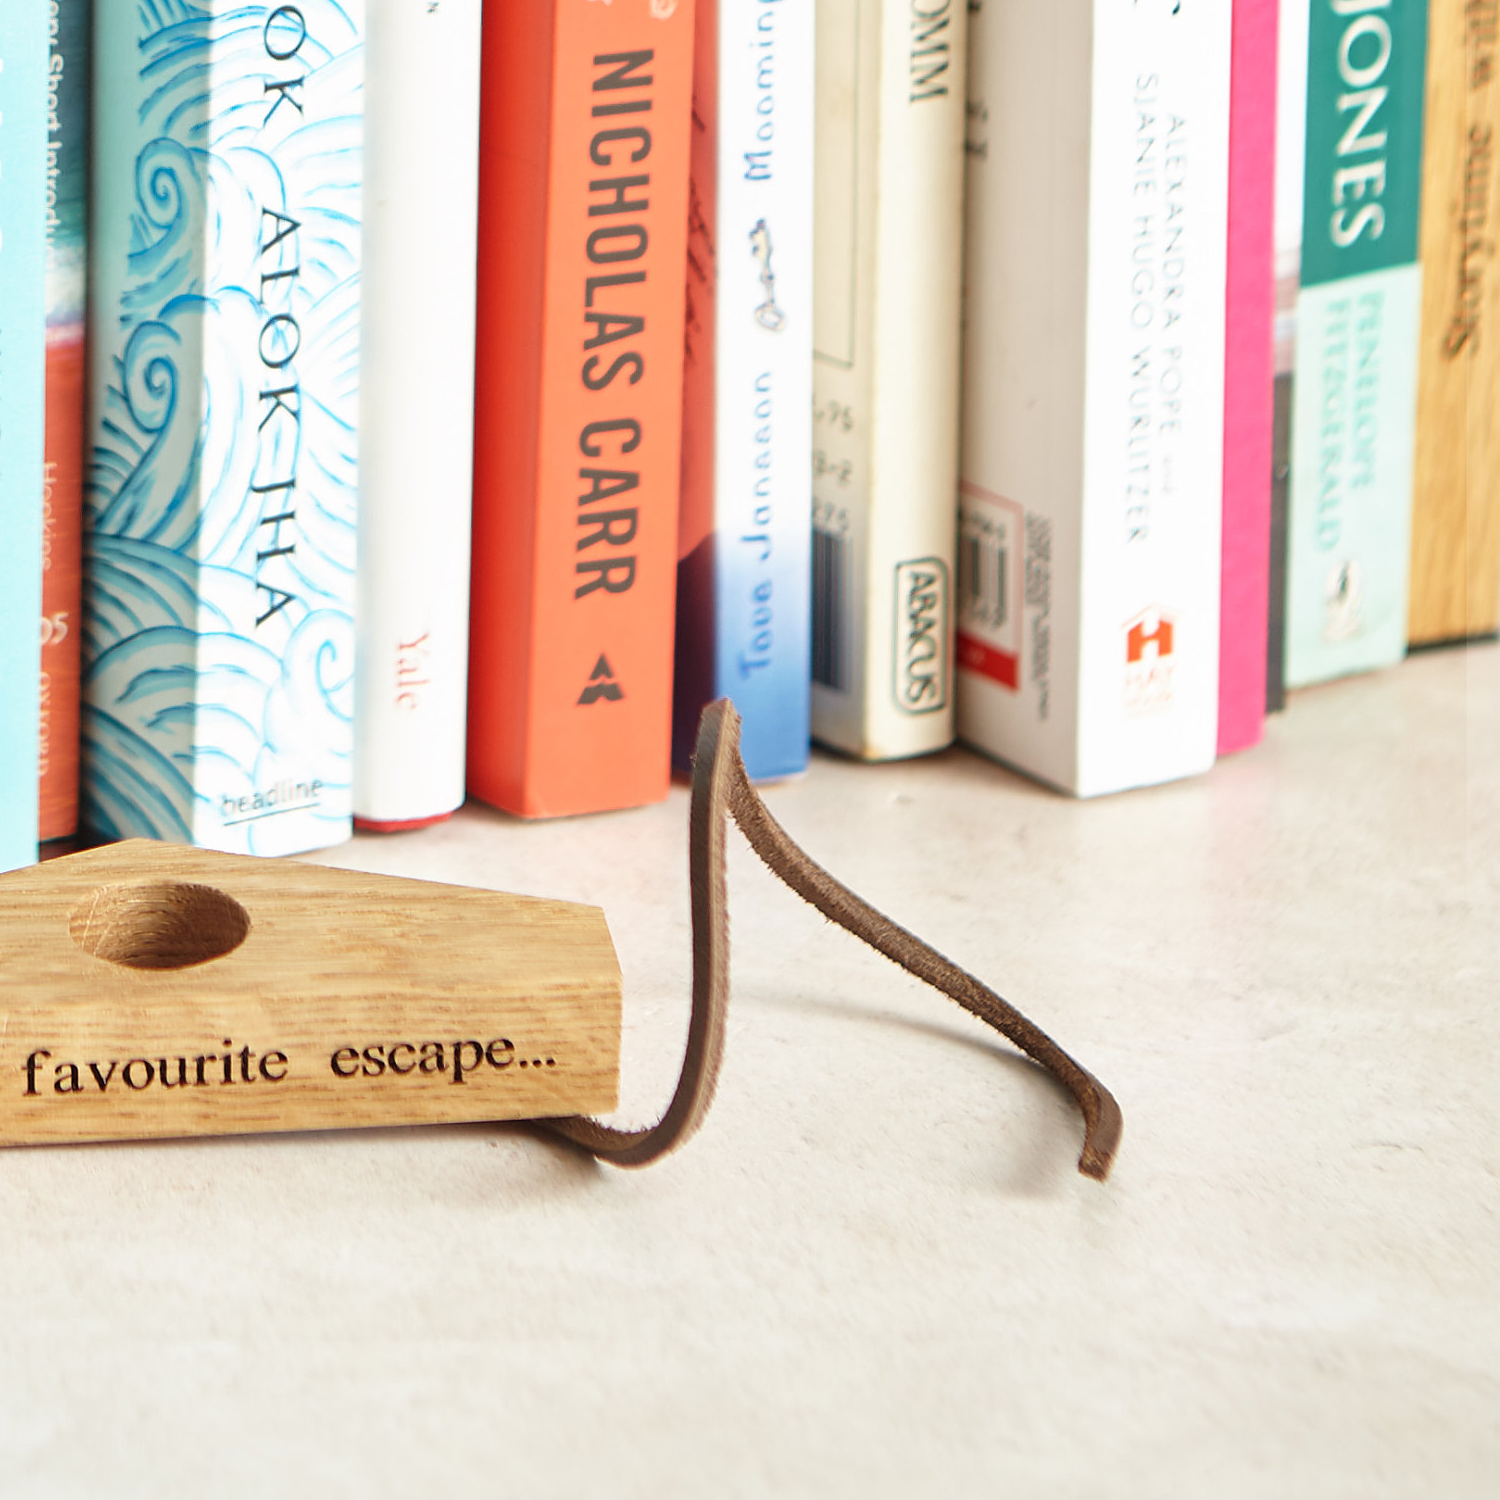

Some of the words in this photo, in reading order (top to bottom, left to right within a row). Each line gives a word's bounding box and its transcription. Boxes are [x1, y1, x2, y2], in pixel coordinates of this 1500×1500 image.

[1133, 72, 1159, 197] SJANIE
[582, 48, 655, 392] NICHOLAS
[1130, 213, 1155, 331] HUGO
[1163, 112, 1187, 331] ALEXANDRA
[257, 206, 301, 434] ALOK
[1125, 344, 1151, 545] WURLITZER
[1159, 345, 1182, 438] POPE
[252, 477, 298, 628] JHA
[574, 417, 643, 601] CARR
[396, 629, 430, 711] Yale
[905, 569, 937, 706] ABACUS
[220, 779, 324, 818] headline
[20, 1038, 289, 1099] favourite
[329, 1035, 558, 1086] escape...
